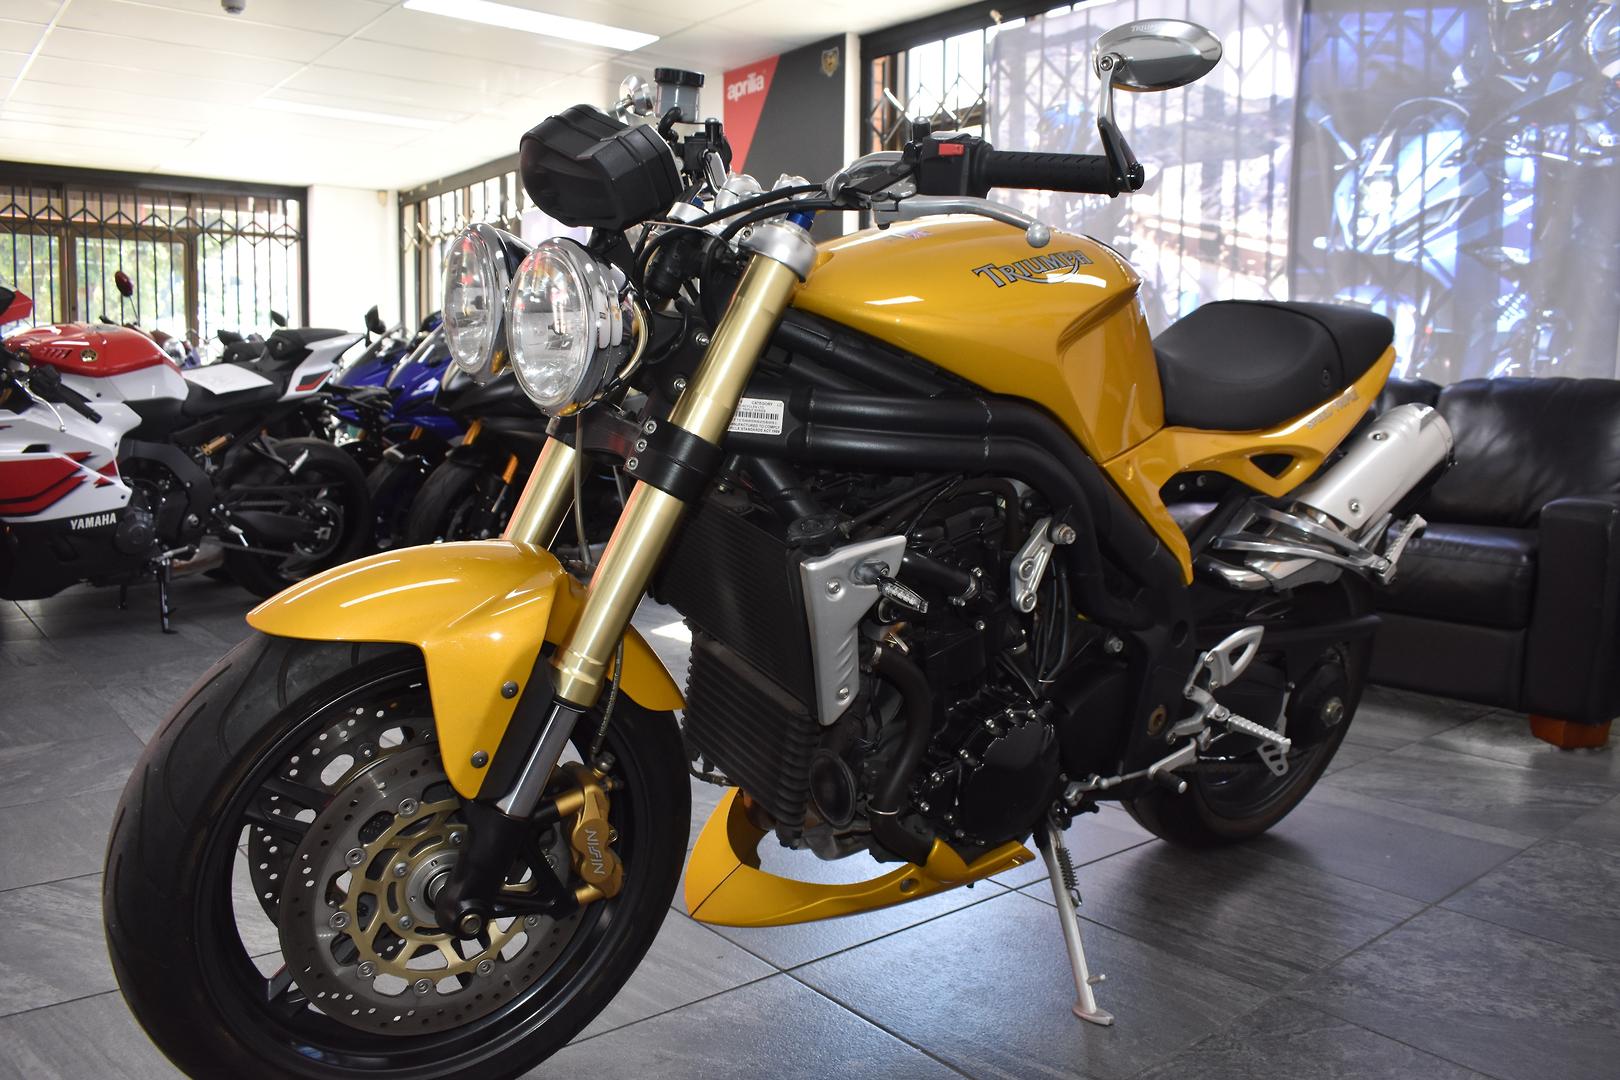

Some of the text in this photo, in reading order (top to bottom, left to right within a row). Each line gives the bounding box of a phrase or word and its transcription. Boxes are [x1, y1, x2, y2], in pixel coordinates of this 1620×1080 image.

[727, 72, 765, 101] aprilia
[971, 249, 1094, 288] TRIUMPH
[70, 512, 117, 530] YAMAHA
